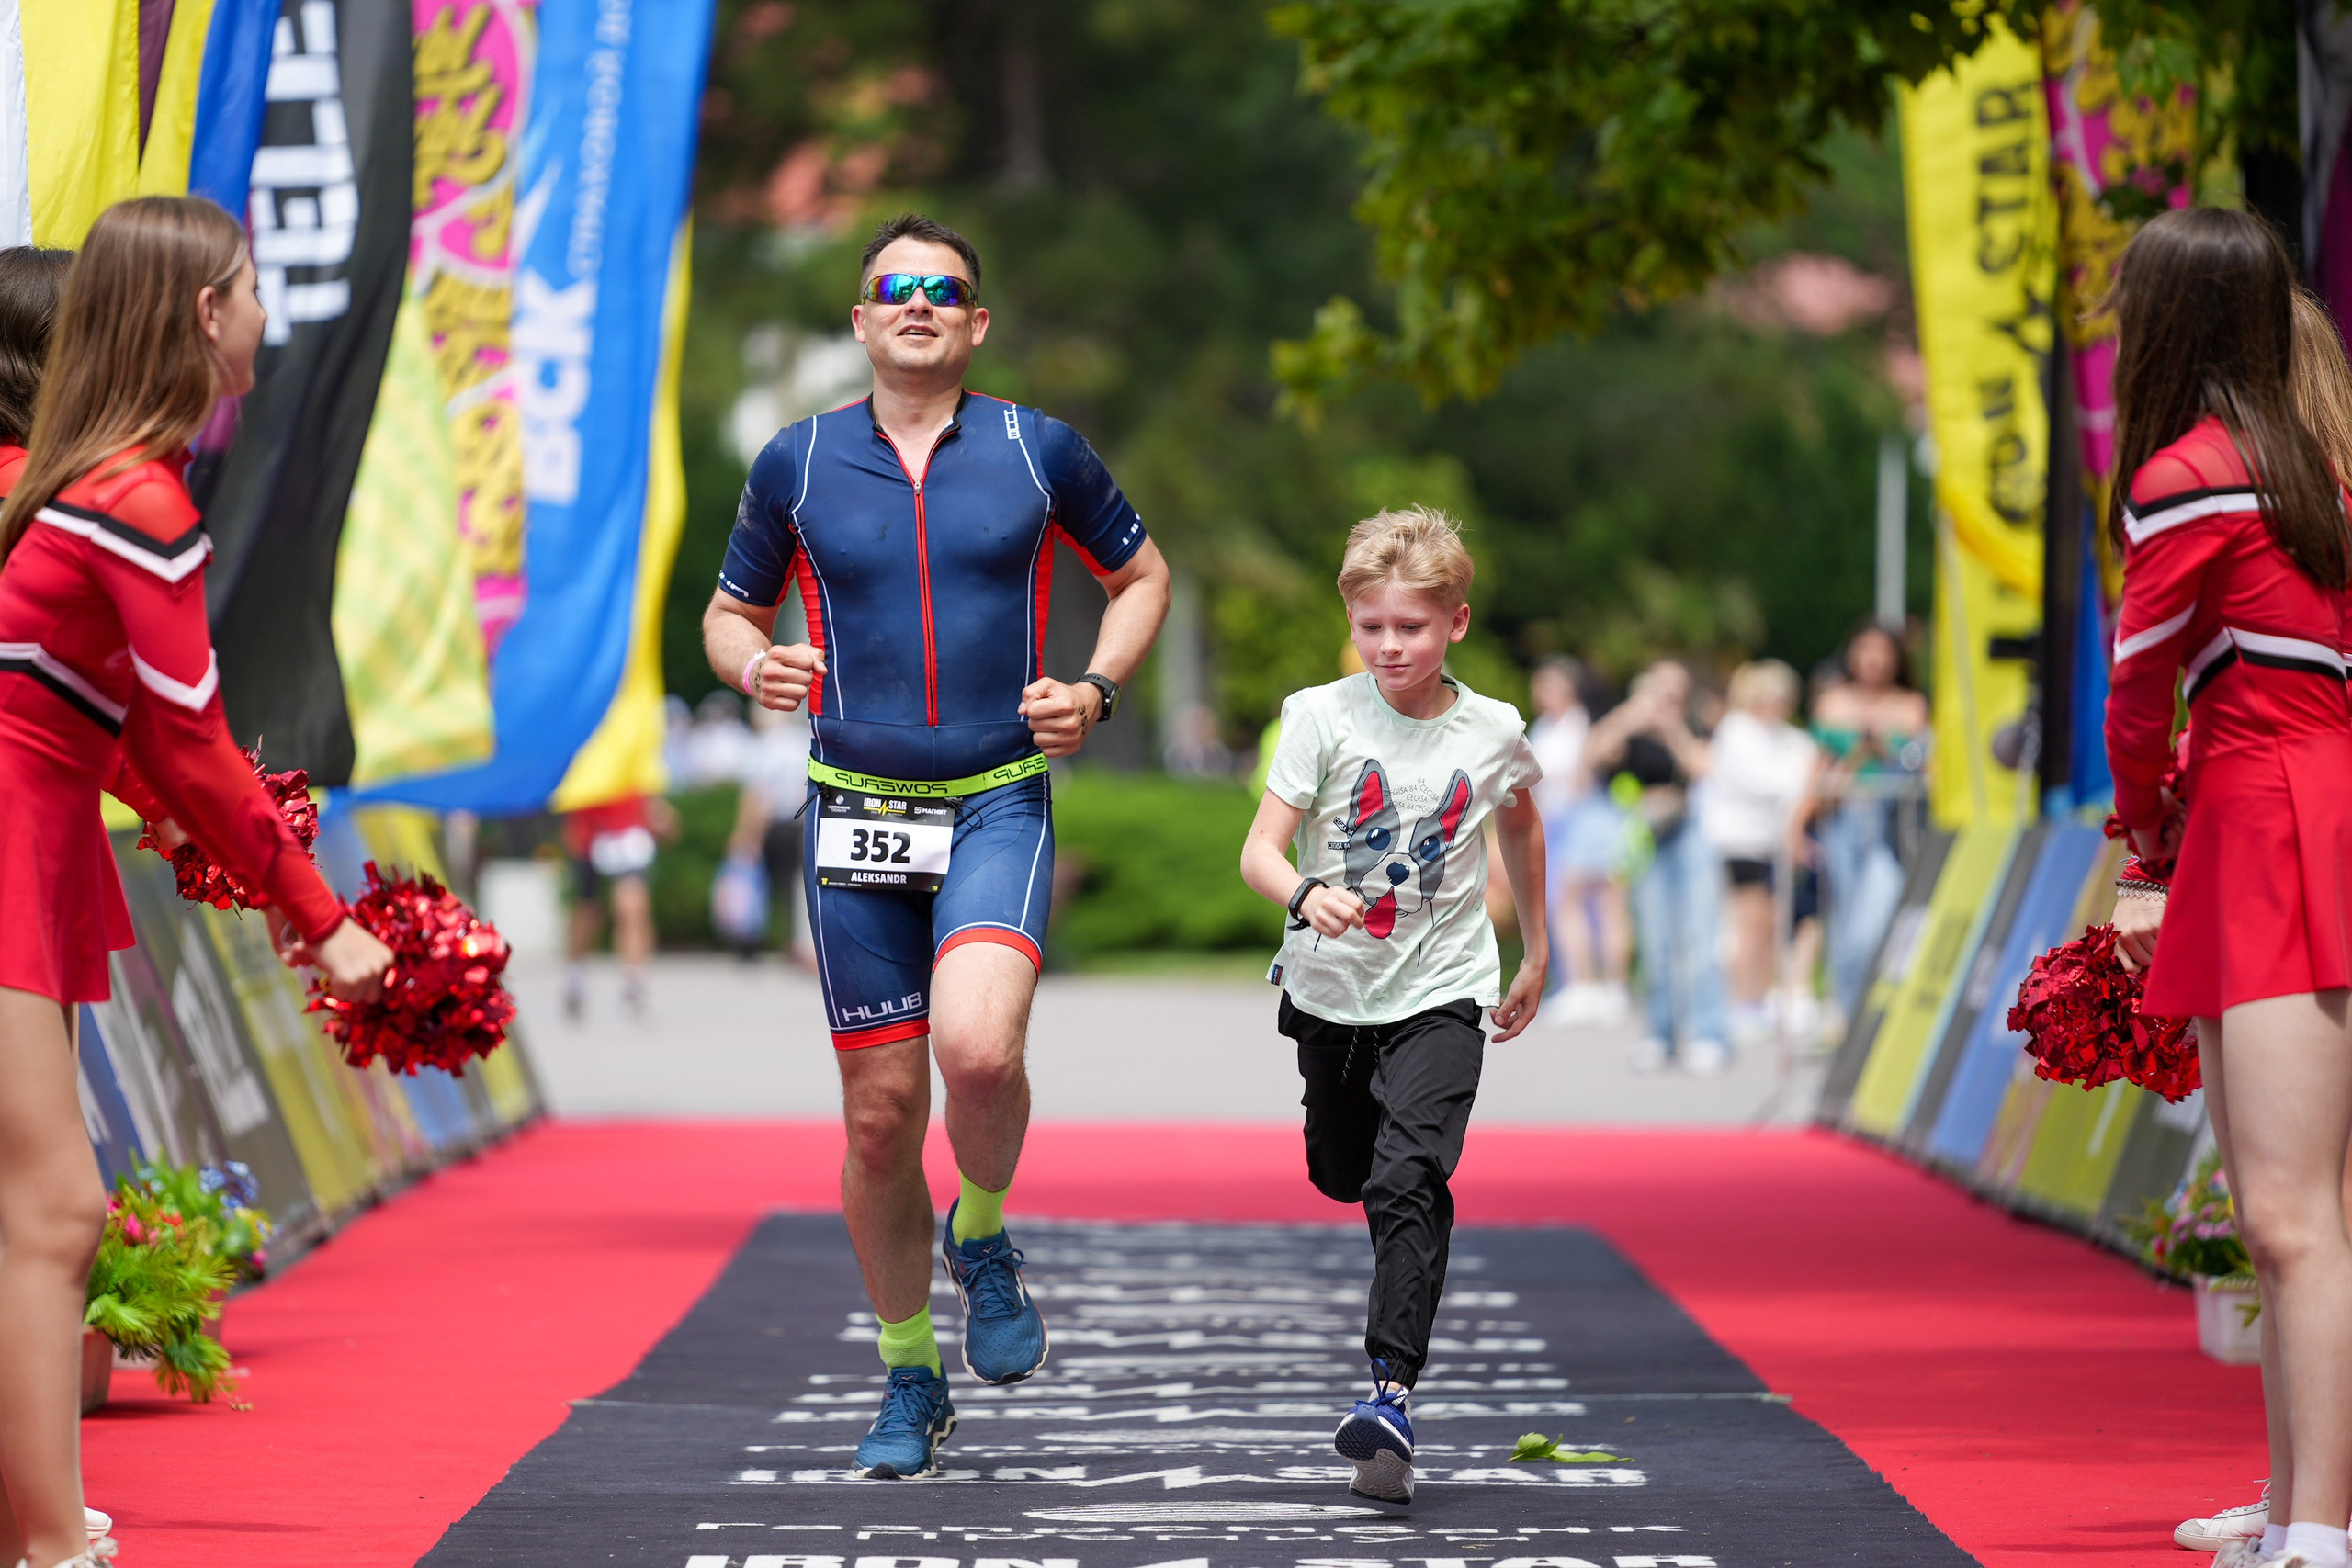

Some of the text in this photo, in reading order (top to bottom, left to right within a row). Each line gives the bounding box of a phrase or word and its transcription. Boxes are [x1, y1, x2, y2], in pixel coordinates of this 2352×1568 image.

[1975, 79, 2034, 276] STAR
[1003, 408, 1021, 440] HUUB
[863, 797, 908, 810] IRON STAR
[1406, 793, 1428, 803] CEGISA
[850, 828, 911, 864] 352
[850, 871, 908, 885] ALEKSANDR
[842, 991, 923, 1023] HUUB
